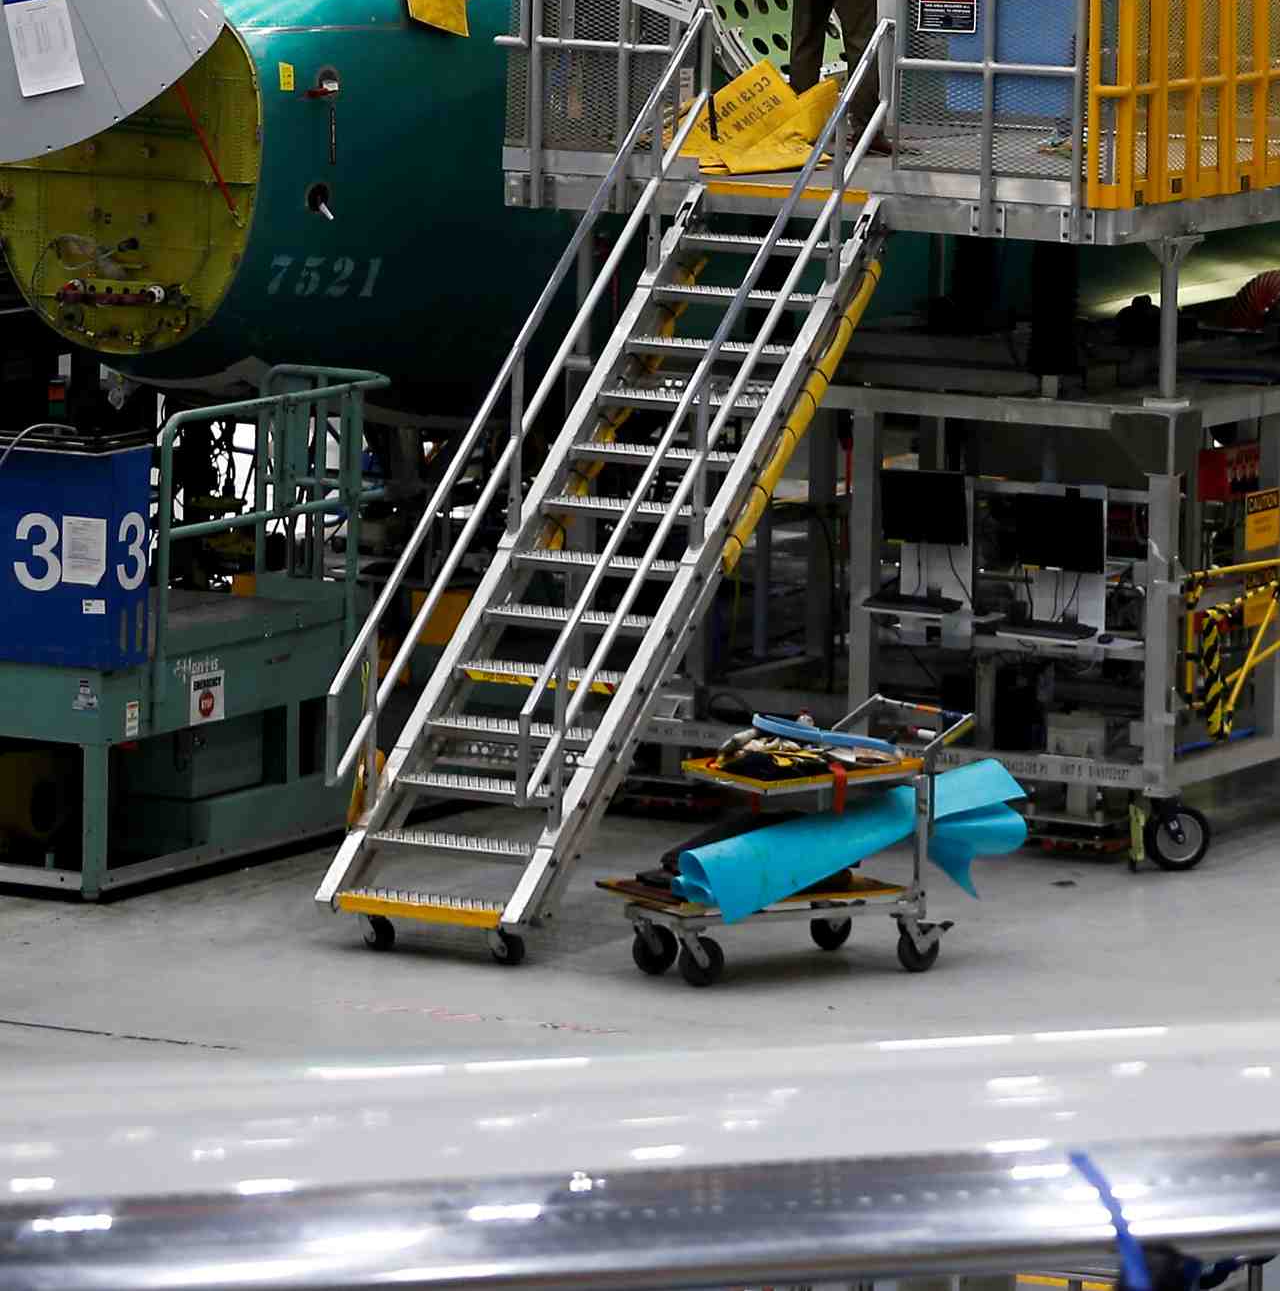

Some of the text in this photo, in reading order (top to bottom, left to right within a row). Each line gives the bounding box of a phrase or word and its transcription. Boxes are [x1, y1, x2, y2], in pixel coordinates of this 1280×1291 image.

[267, 253, 383, 298] 7521
[14, 513, 62, 591] 3
[117, 512, 147, 590] 3
